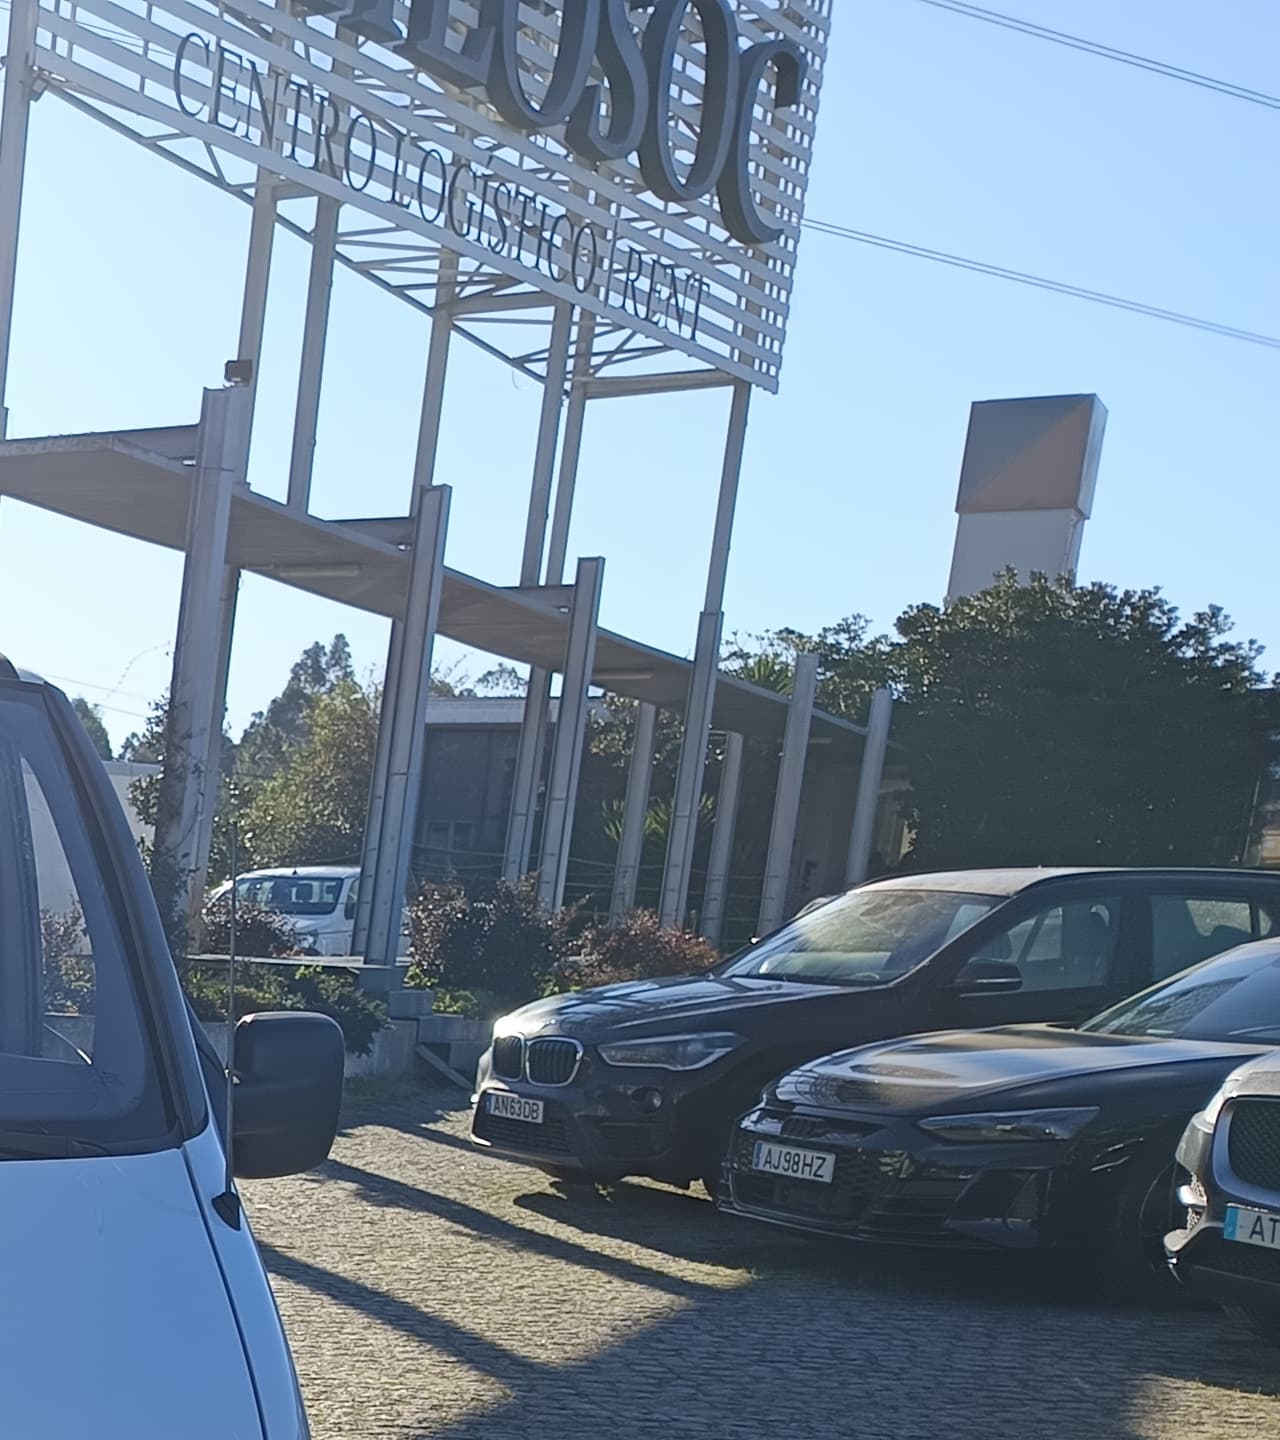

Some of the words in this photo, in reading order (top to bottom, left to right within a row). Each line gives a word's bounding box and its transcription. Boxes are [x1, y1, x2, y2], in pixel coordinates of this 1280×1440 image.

[173, 32, 377, 191] CENTRO
[621, 244, 711, 341] RENT
[493, 1096, 540, 1120] AN63DB
[762, 1147, 827, 1179] AJ98HZ
